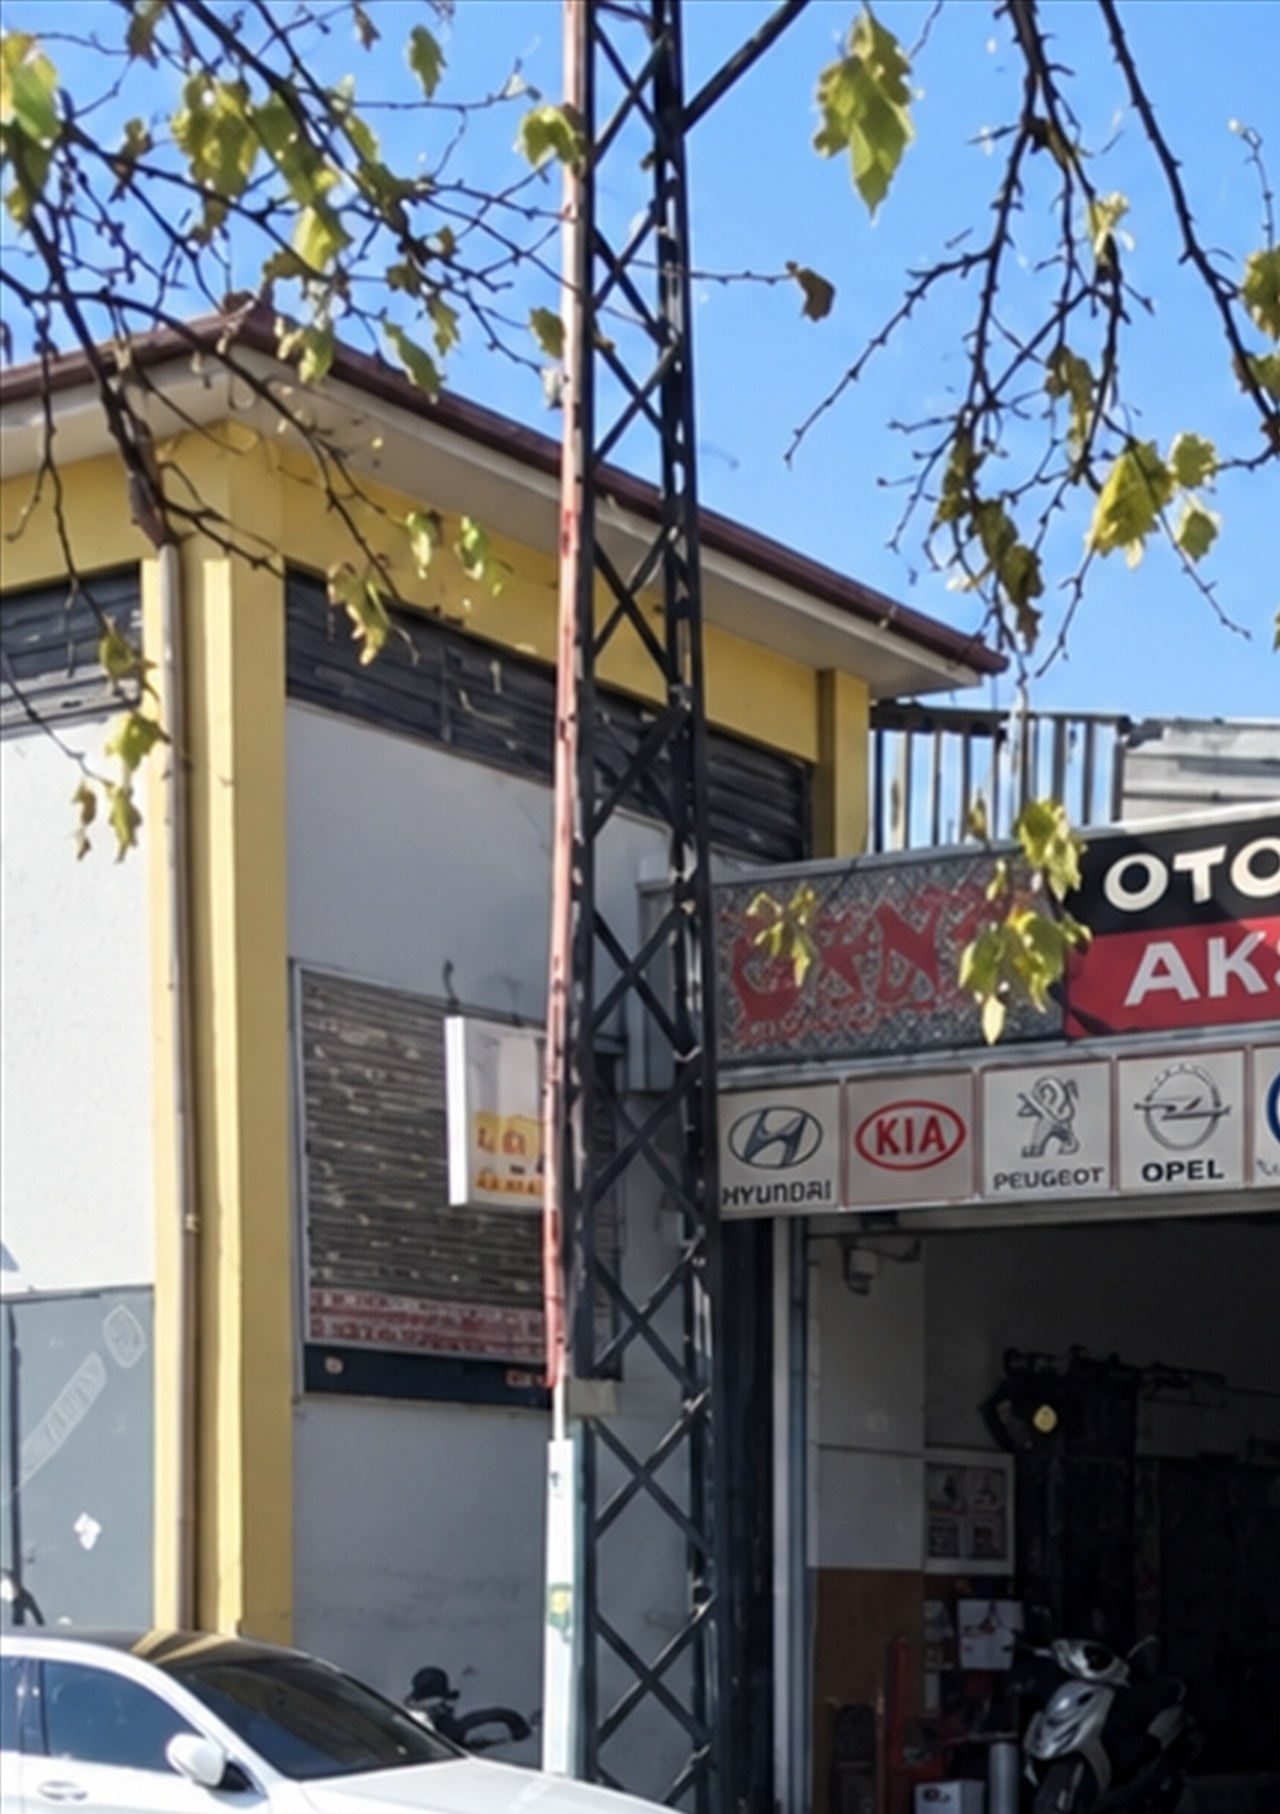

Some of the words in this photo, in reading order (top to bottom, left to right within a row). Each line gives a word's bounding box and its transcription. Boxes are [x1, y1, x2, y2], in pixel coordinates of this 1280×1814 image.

[875, 1117, 947, 1155] KIA
[993, 1167, 1104, 1190] PEUGEOT
[1141, 1159, 1223, 1183] OPEL
[722, 1180, 832, 1207] HYUNDAI
